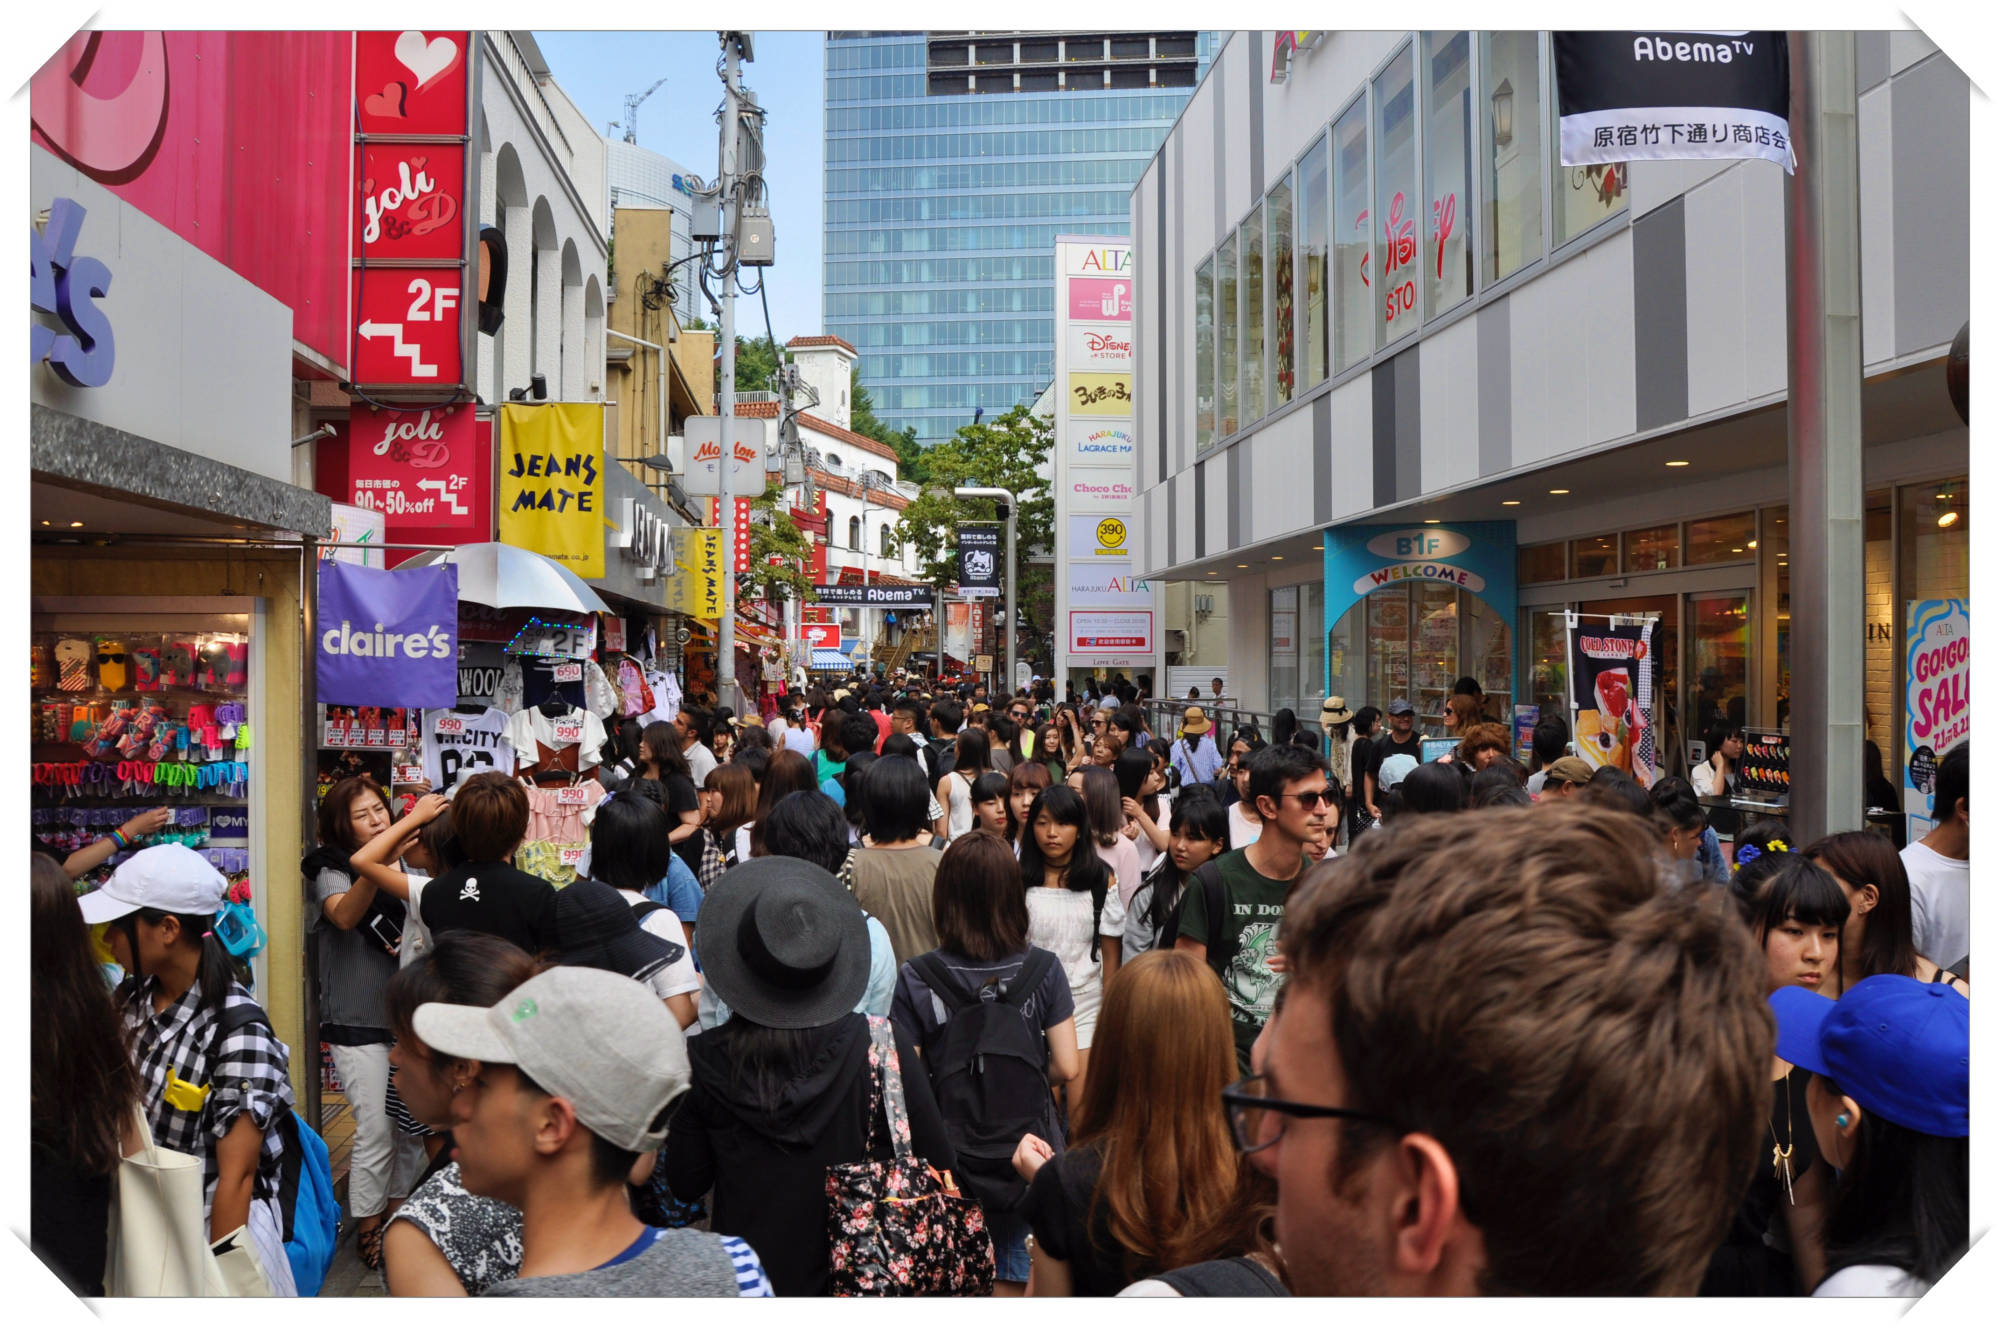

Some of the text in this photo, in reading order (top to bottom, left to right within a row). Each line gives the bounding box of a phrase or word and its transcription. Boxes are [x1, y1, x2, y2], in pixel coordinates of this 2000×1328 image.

[1633, 36, 1754, 64] AbemaTV
[1593, 122, 1786, 150] 原宿竹下通り商店会
[407, 278, 460, 322] 2F
[1078, 442, 1117, 453] LAGRACE
[508, 453, 597, 486] JEANS
[449, 474, 468, 490] 2F
[1074, 484, 1109, 493] Choco
[511, 488, 593, 513] MATE
[1100, 524, 1123, 535] 390
[1396, 532, 1440, 555] B1F
[702, 534, 717, 614] JEANS MATE
[1370, 564, 1469, 586] WELCOME
[1107, 576, 1150, 593] ALTA
[322, 620, 450, 659] claire's
[1603, 637, 1634, 657] STONE
[556, 666, 580, 677] 690
[439, 719, 462, 731] 990
[556, 727, 579, 738] 990
[561, 788, 584, 799] 990
[1233, 904, 1253, 915] IN
